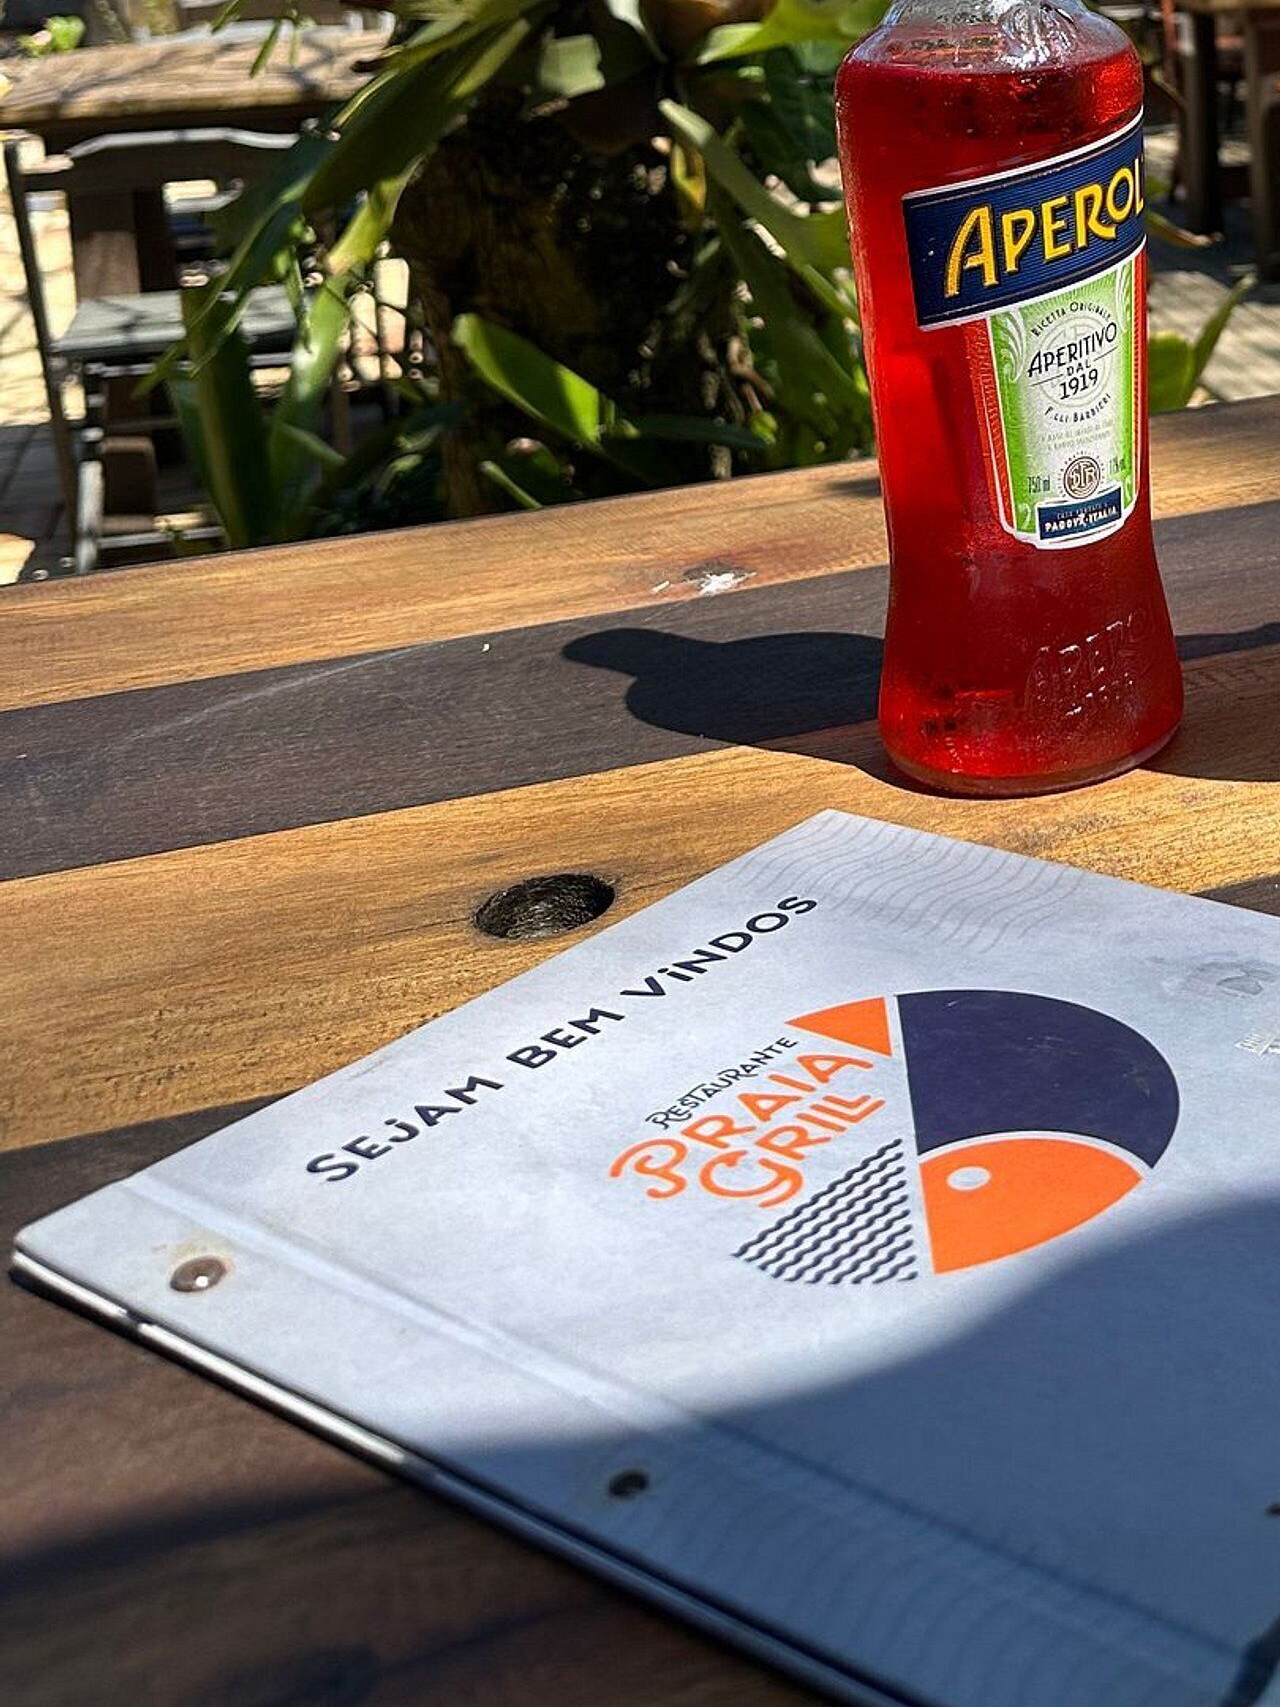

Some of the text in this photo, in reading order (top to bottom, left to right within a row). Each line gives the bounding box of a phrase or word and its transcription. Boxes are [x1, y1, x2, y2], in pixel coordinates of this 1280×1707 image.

[944, 157, 1145, 299] APEROL
[1027, 321, 1118, 378] APERITIVO
[1030, 307, 1067, 337] RICETTA
[1060, 368, 1099, 401] 1919
[1066, 359, 1092, 377] DAL
[1073, 392, 1112, 424] BARBIERI
[306, 894, 818, 1183] SEJAM BEM VINDOS
[645, 1036, 799, 1131] RESTAURANTE
[609, 1054, 874, 1200] PRAIA
[699, 1094, 887, 1209] GRILL
